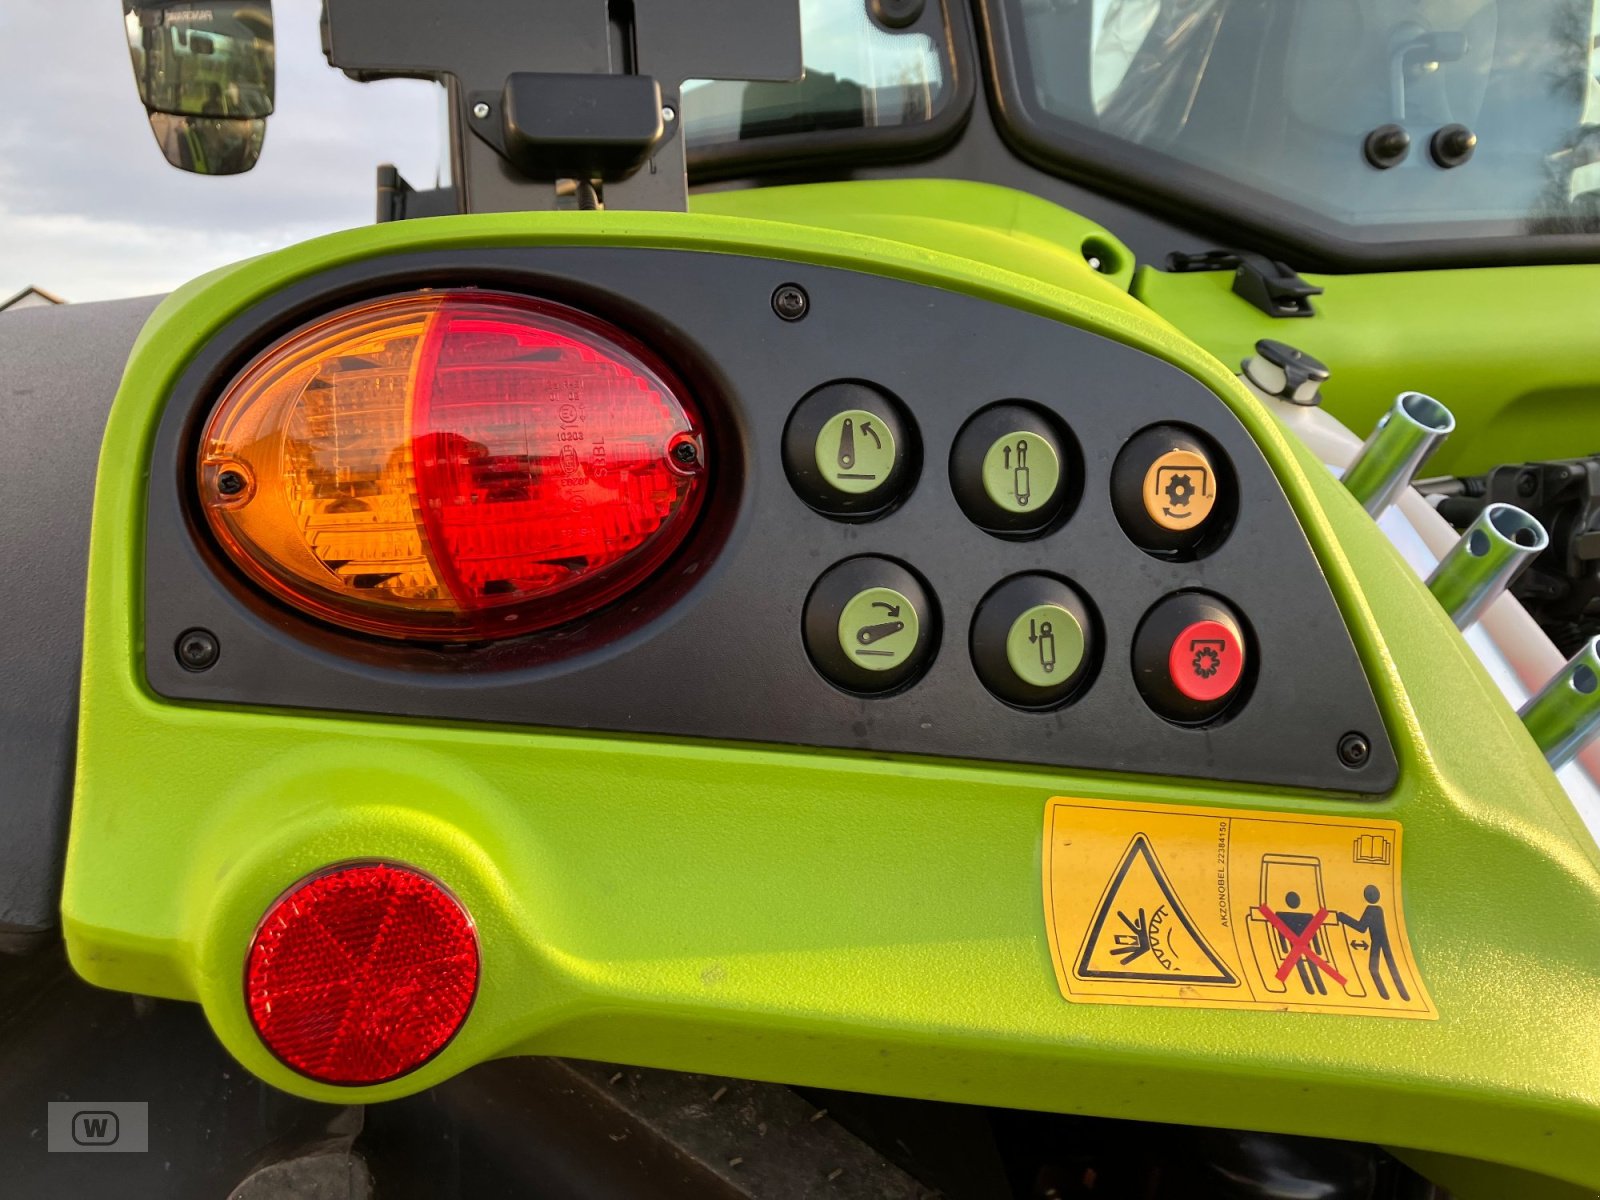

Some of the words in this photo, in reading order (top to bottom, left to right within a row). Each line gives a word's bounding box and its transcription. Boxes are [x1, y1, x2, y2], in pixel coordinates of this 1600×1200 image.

[556, 432, 584, 442] 10203
[592, 436, 607, 479] SBBL
[1217, 822, 1227, 865] 22384150
[1217, 868, 1229, 928] AKZONOBEL
